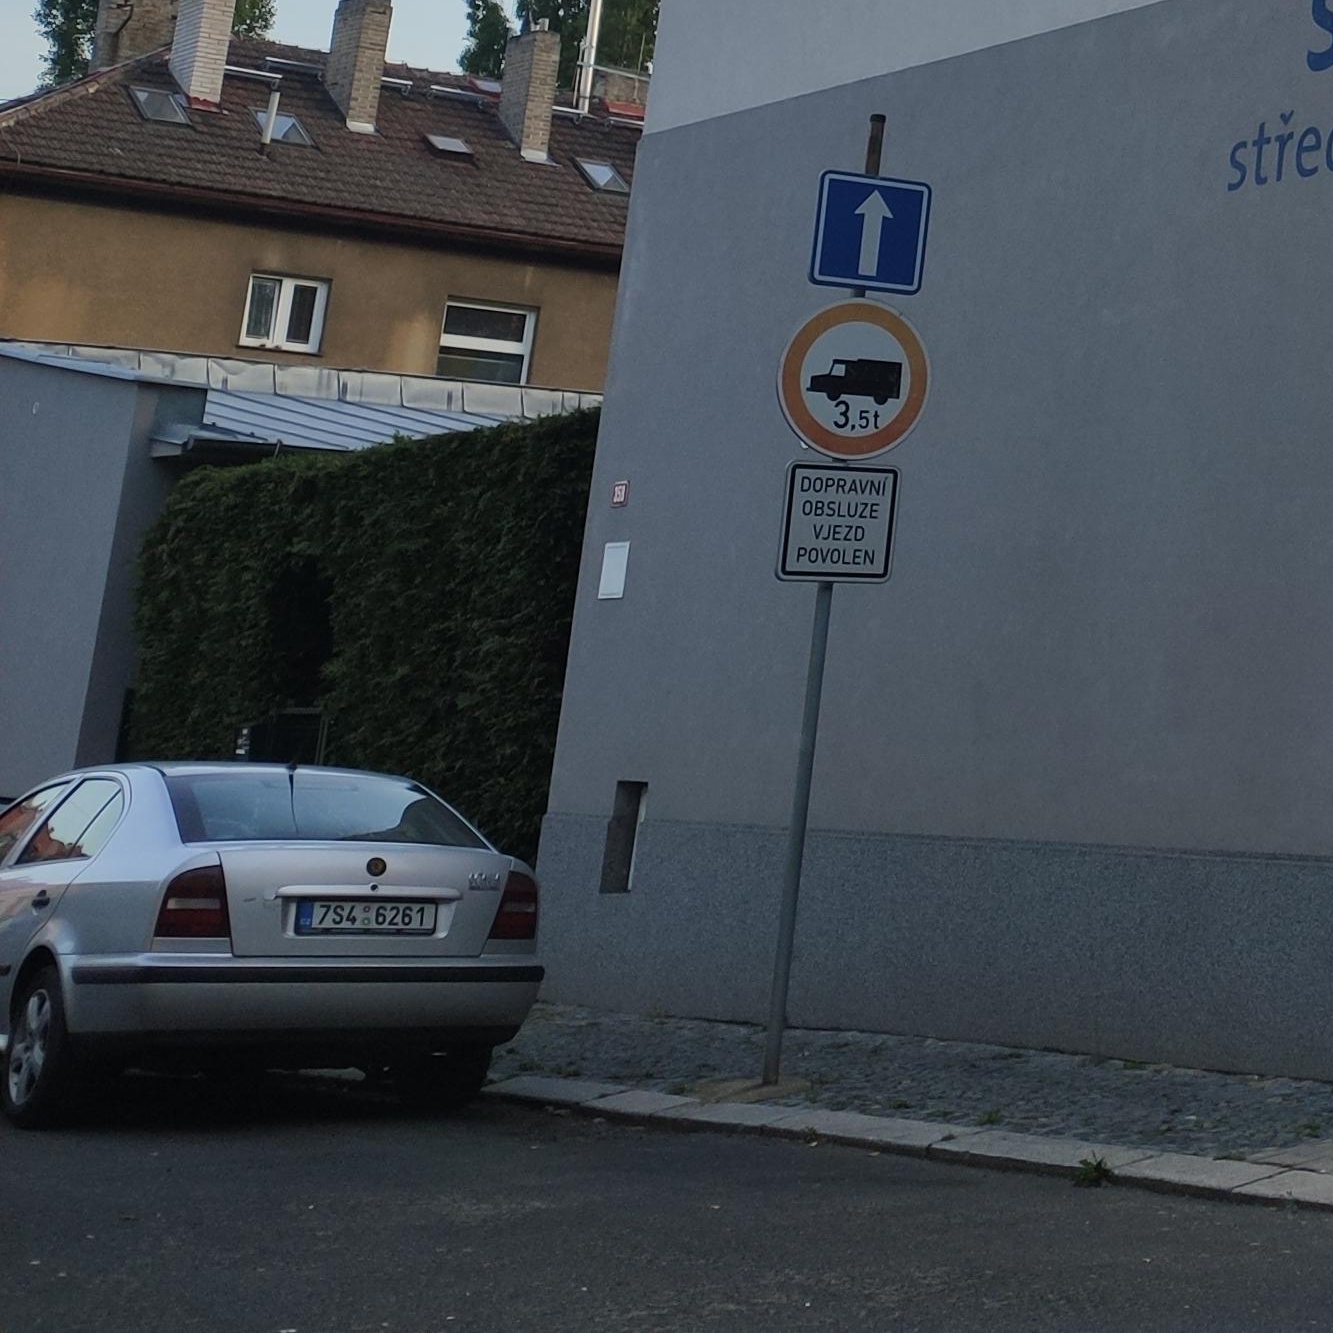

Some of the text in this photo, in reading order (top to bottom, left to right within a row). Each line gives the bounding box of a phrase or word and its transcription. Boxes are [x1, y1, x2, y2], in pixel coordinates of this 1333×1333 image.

[800, 476, 888, 497] DOPRAVNÍ
[802, 500, 880, 519] OBSLUZE
[813, 524, 865, 542] VJEZD
[797, 547, 875, 566] POVOLEN
[318, 904, 426, 927] 7S4 6261
